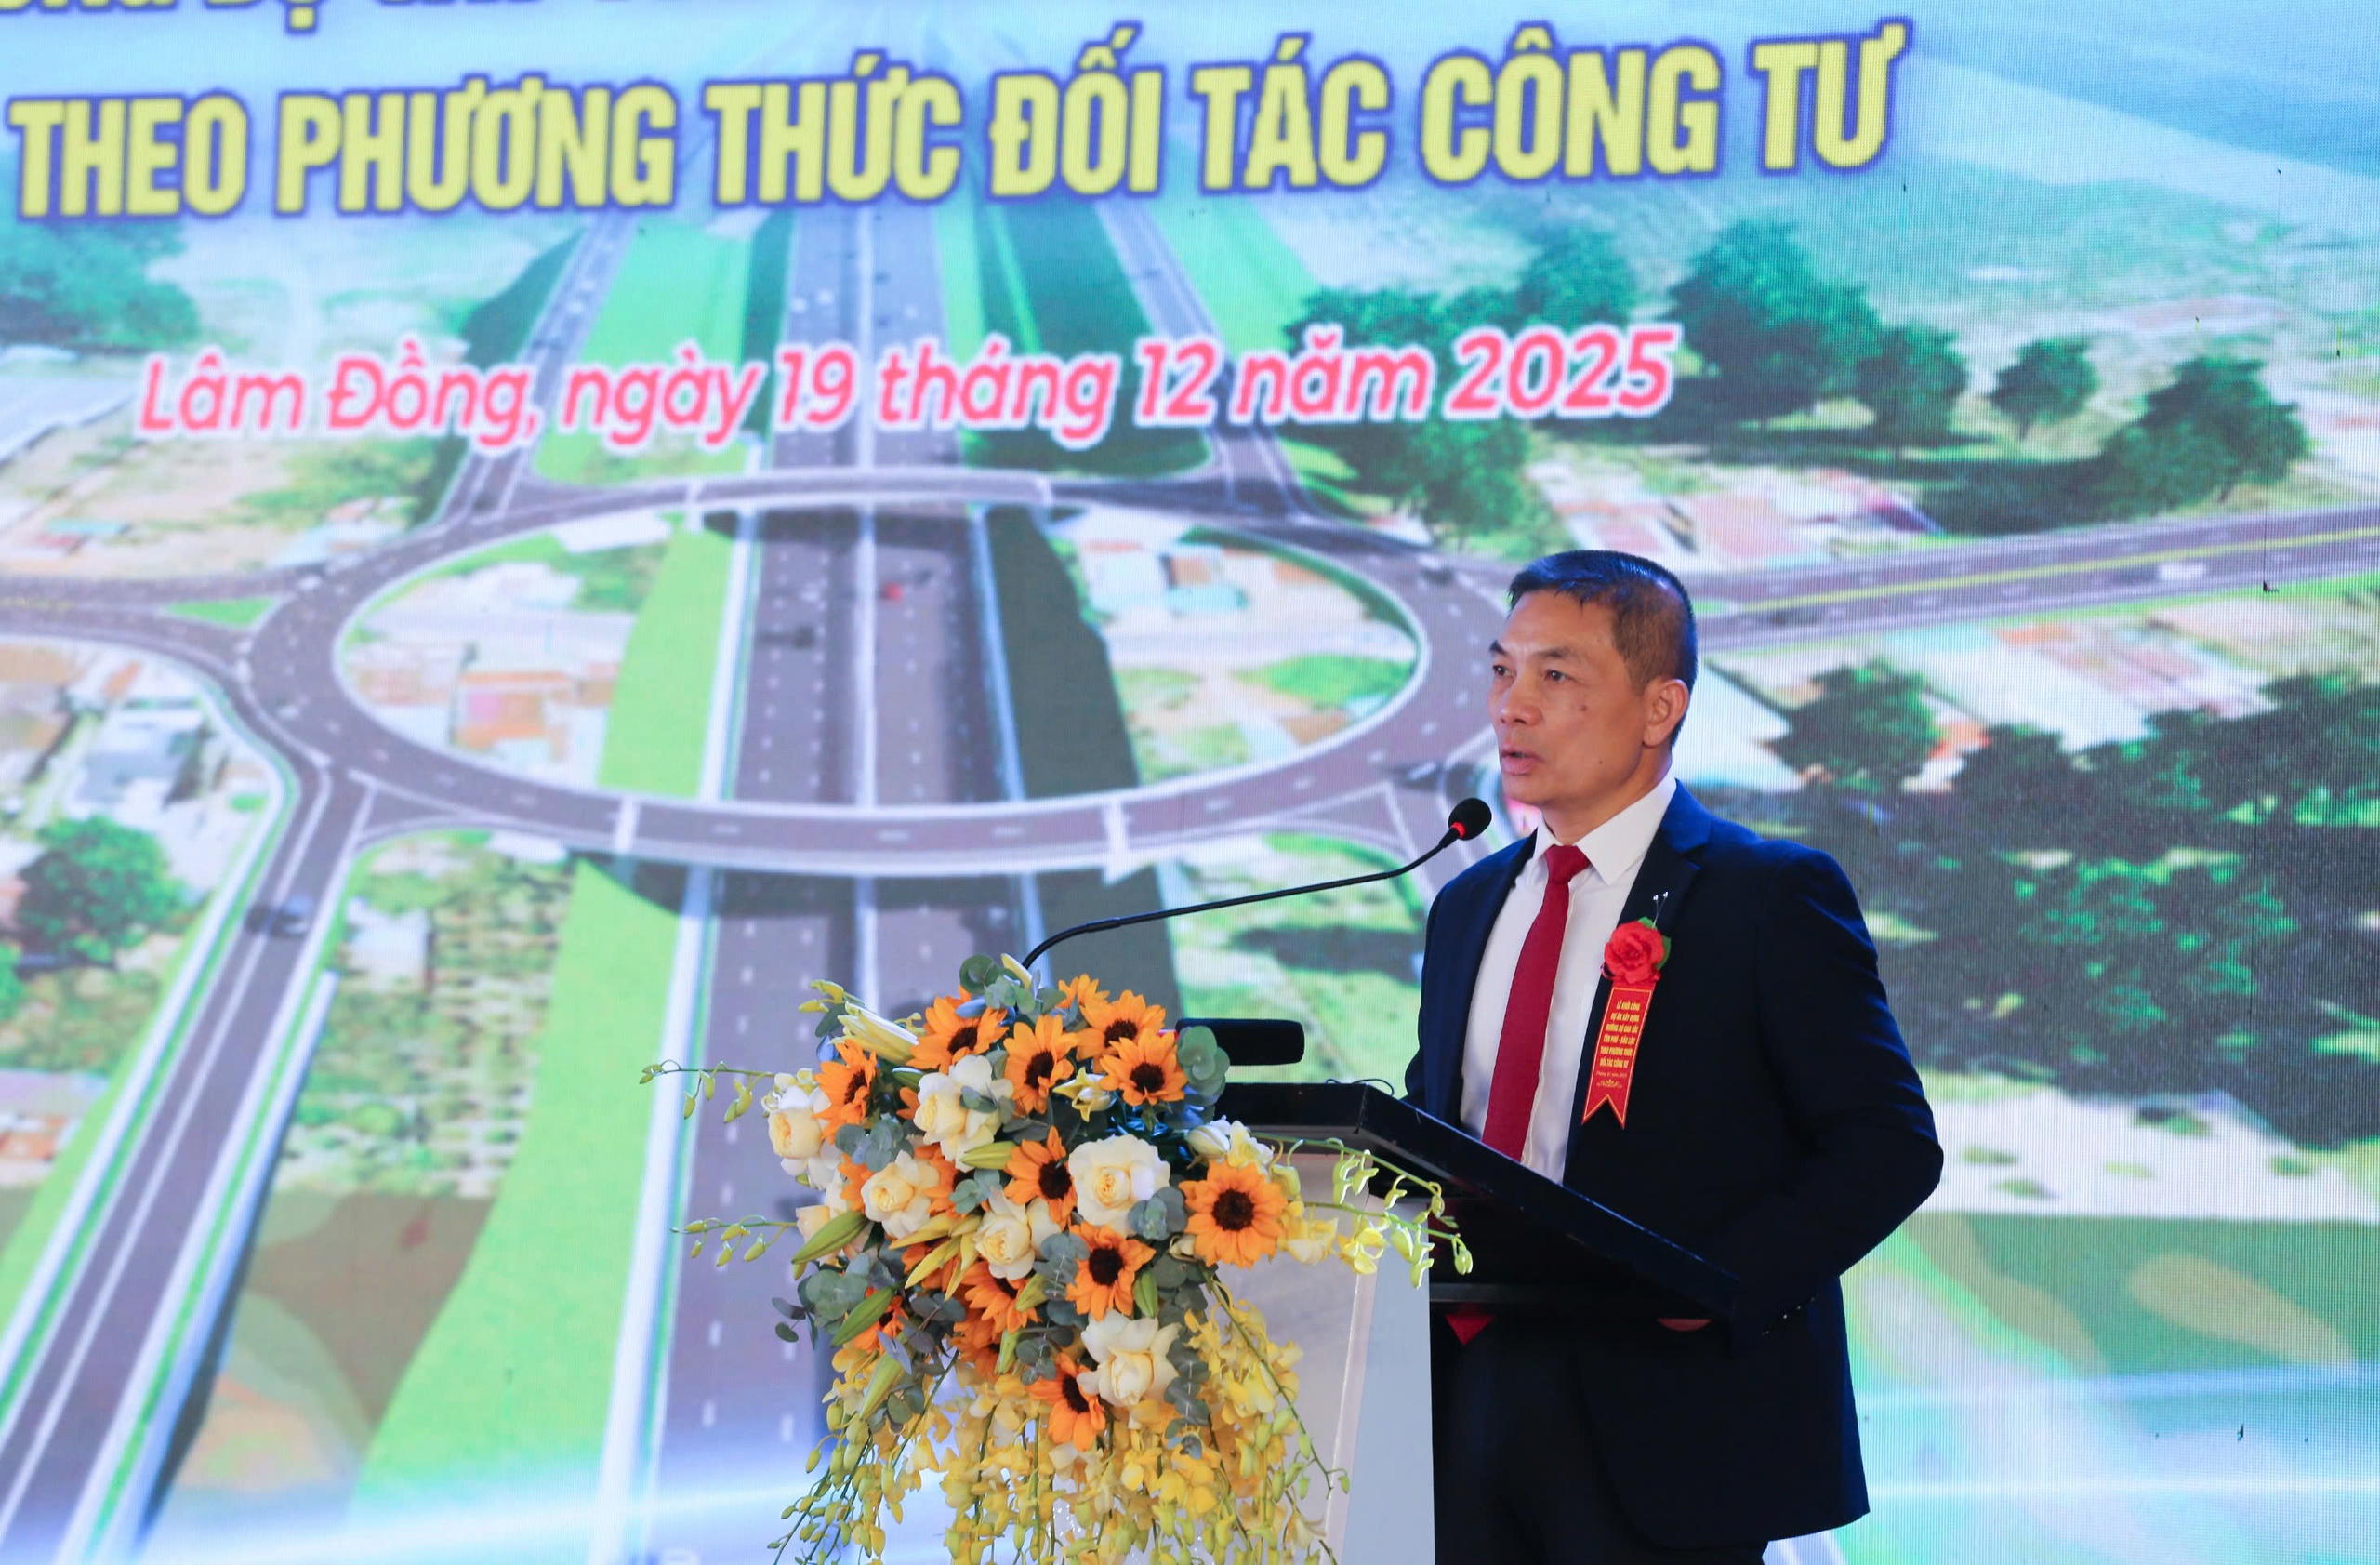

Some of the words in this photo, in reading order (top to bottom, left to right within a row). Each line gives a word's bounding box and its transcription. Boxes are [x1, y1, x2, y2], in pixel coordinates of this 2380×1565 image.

[10, 98, 247, 216] THEO
[276, 77, 676, 212] PHƯƠNG
[705, 54, 961, 203] THỨC
[989, 27, 1162, 195] ĐỐI
[1193, 37, 1388, 189] TÁC
[1421, 27, 1720, 181] CÔNG
[1753, 24, 1907, 169] TƯ
[140, 354, 303, 430] Lâm
[327, 341, 536, 446] Đồng,
[562, 349, 764, 444] ngày
[778, 350, 854, 424] 19
[879, 339, 1117, 440] tháng
[1137, 340, 1220, 418] 12
[1236, 328, 1432, 418] năm
[1448, 329, 1675, 411] 2025
